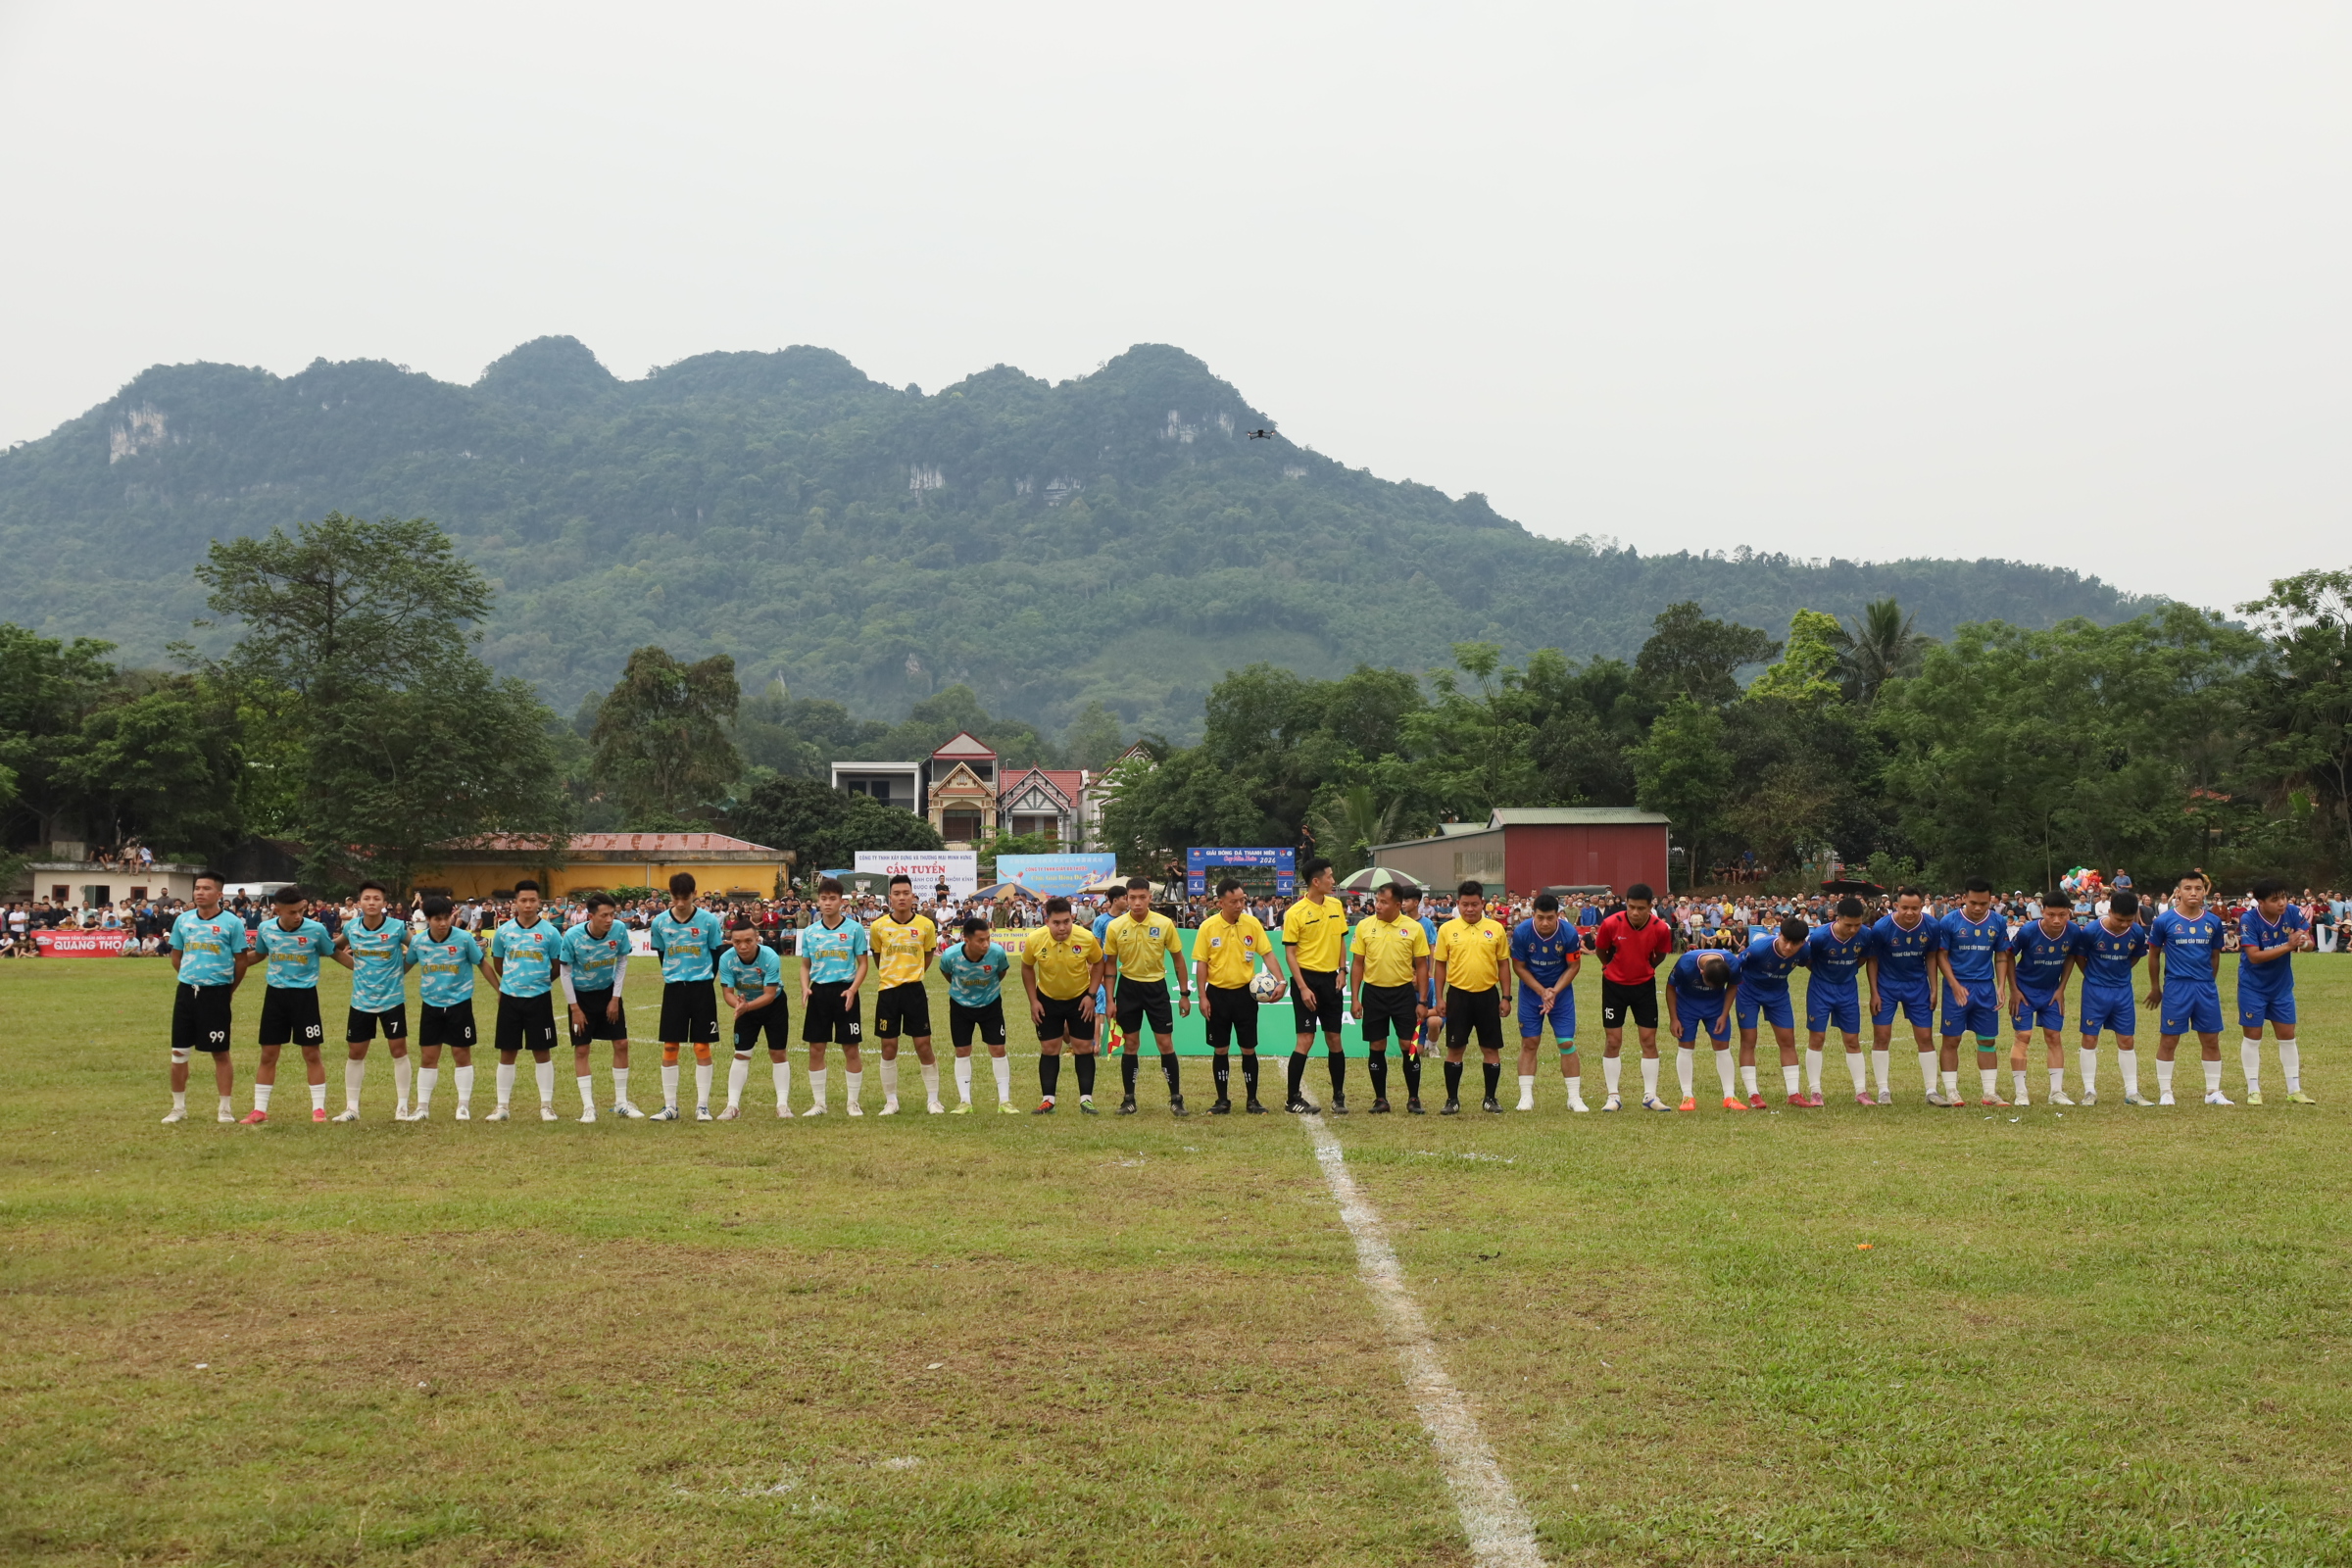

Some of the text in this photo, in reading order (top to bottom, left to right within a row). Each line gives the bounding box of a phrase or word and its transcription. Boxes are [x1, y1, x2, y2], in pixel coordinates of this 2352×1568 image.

[911, 861, 945, 874] TUYỂN
[54, 941, 96, 950] QUANG
[1605, 1007, 1614, 1020] 15
[305, 1024, 321, 1038] 88
[391, 1022, 398, 1033] 7
[465, 1027, 471, 1039] 8
[849, 1023, 860, 1035] 18
[1000, 1025, 1005, 1036] 6
[209, 1031, 225, 1043] 99
[545, 1028, 551, 1040] 11
